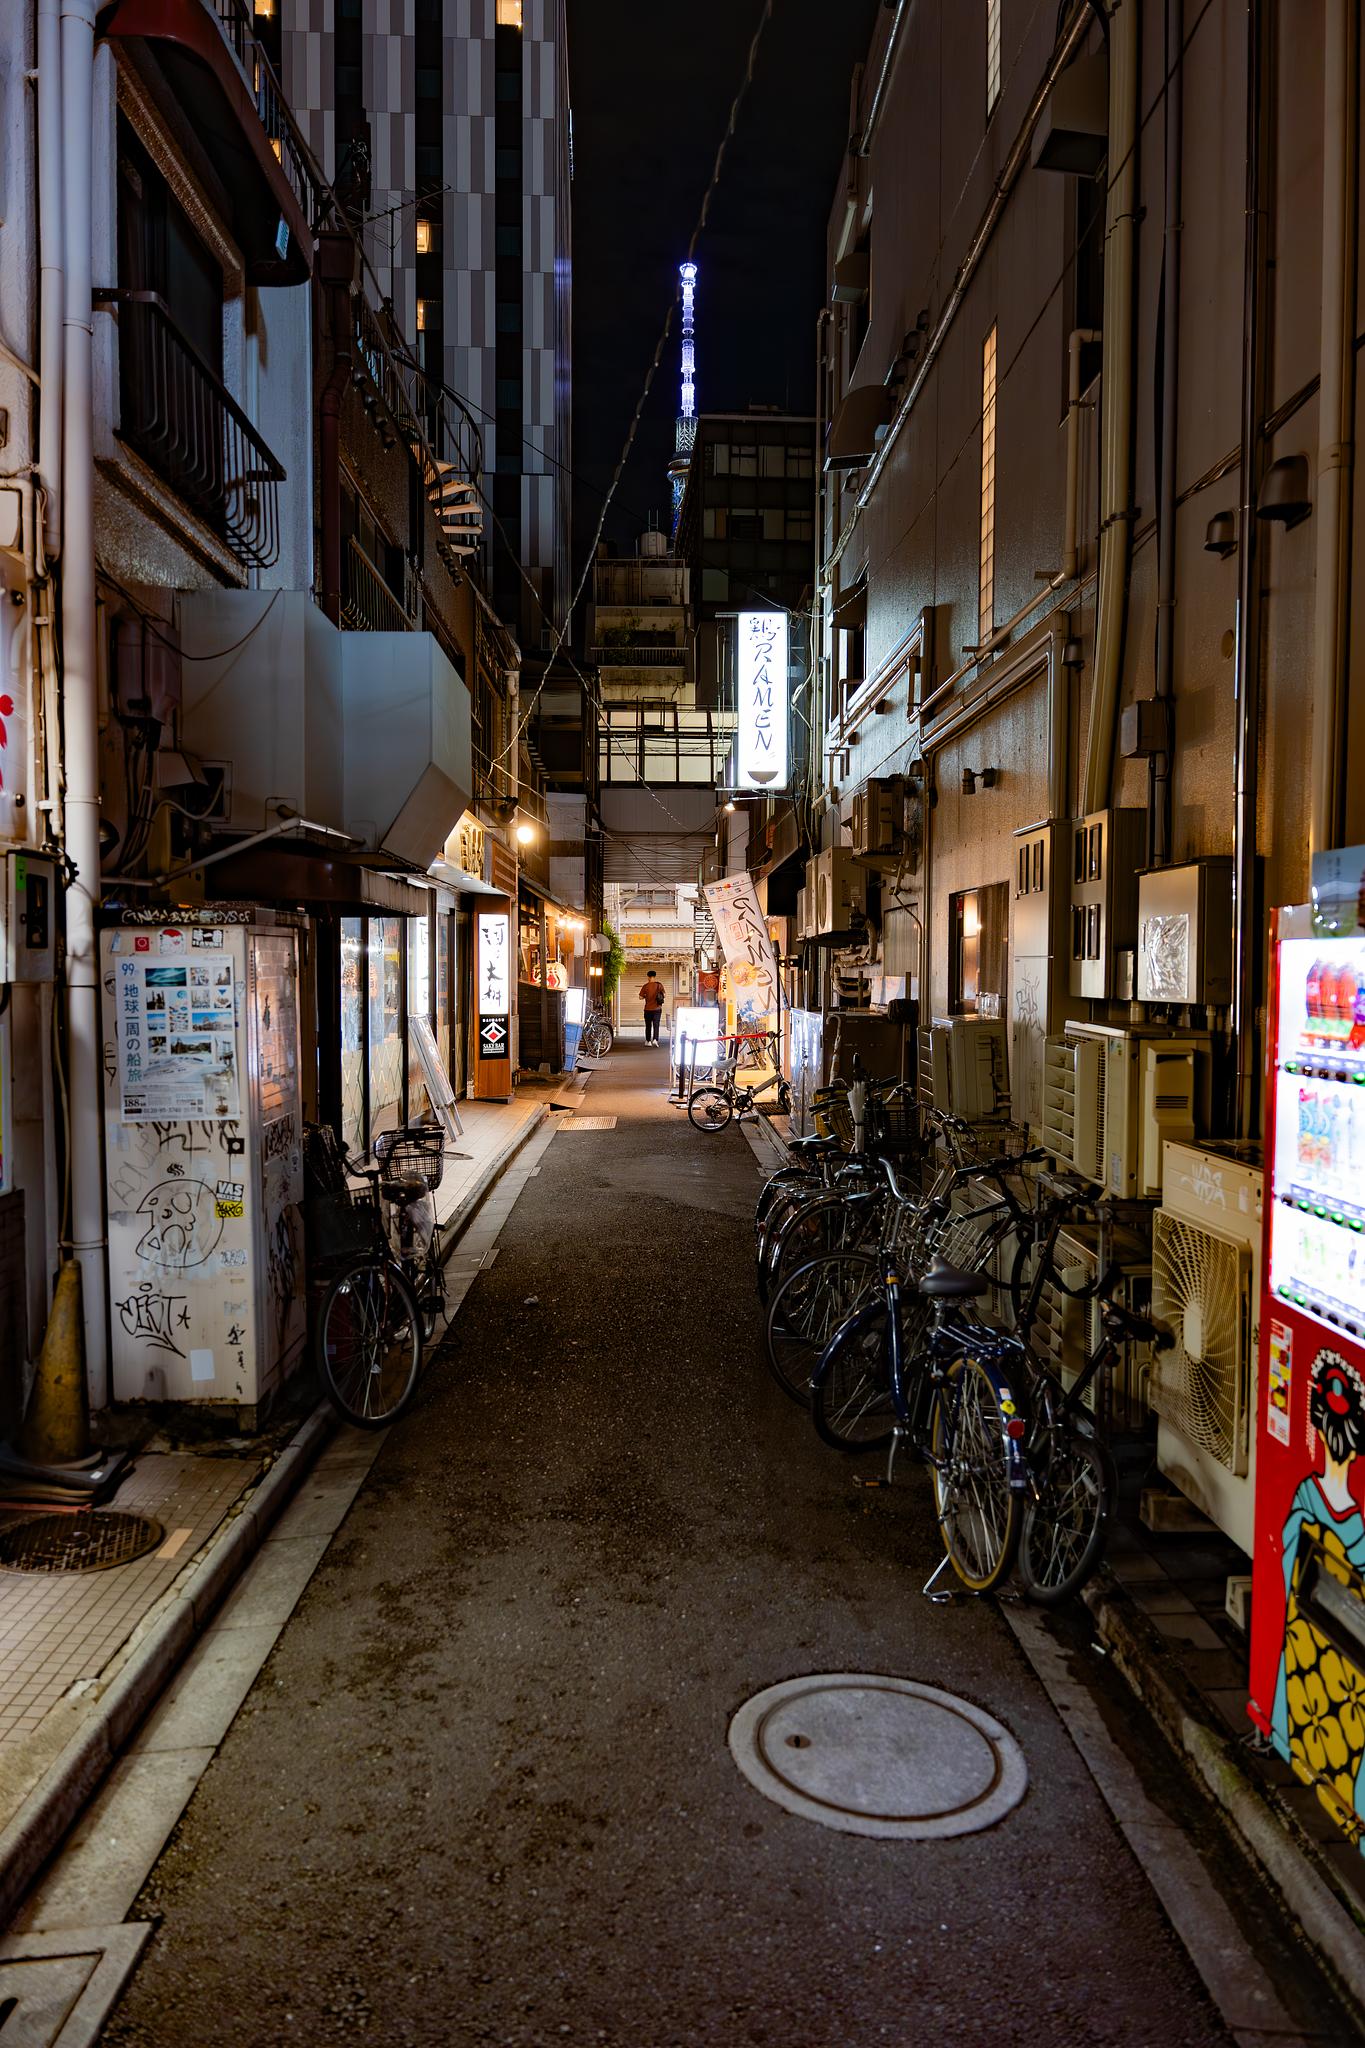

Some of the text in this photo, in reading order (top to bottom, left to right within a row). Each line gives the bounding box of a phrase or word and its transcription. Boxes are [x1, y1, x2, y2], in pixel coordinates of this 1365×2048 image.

[122, 984, 143, 1083] 地球一周の船旅
[218, 1181, 243, 1196] VAS
